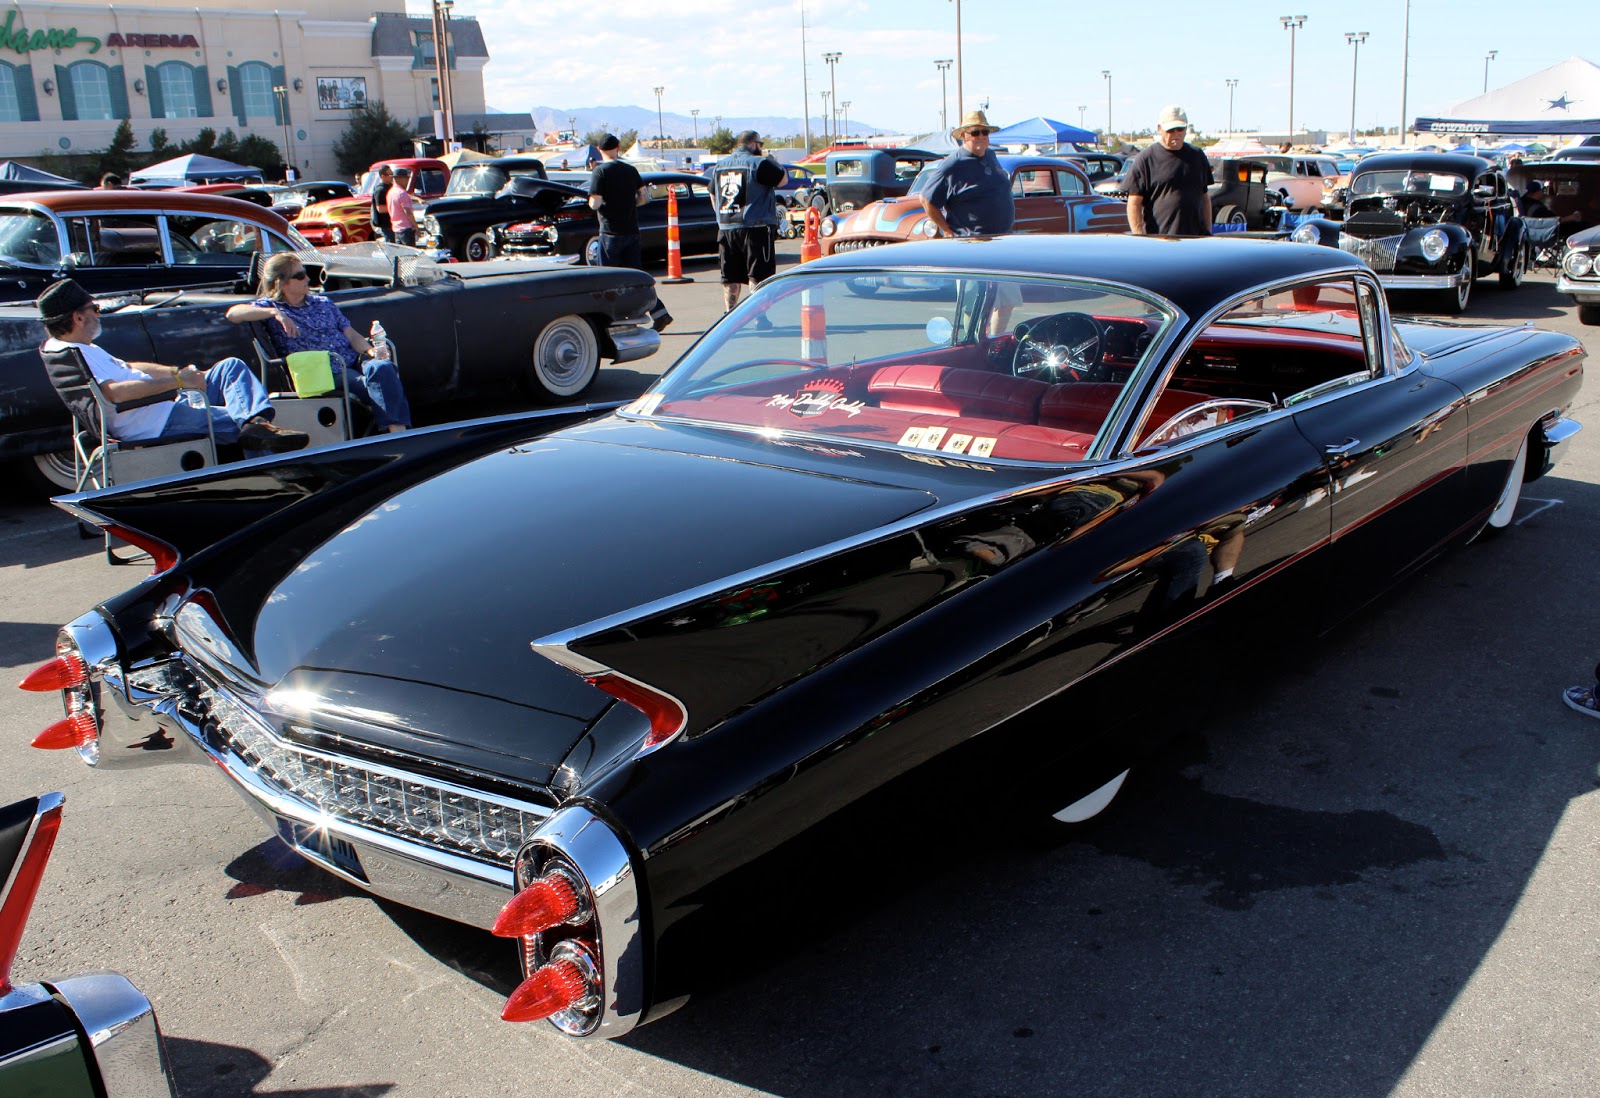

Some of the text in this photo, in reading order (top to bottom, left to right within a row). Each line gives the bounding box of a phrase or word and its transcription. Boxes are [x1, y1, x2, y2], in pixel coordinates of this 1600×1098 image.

[0, 10, 200, 54] leans ARENA
[1430, 122, 1489, 132] COWBOYS
[793, 393, 834, 411] Daddy
[829, 397, 866, 418] Caddy
